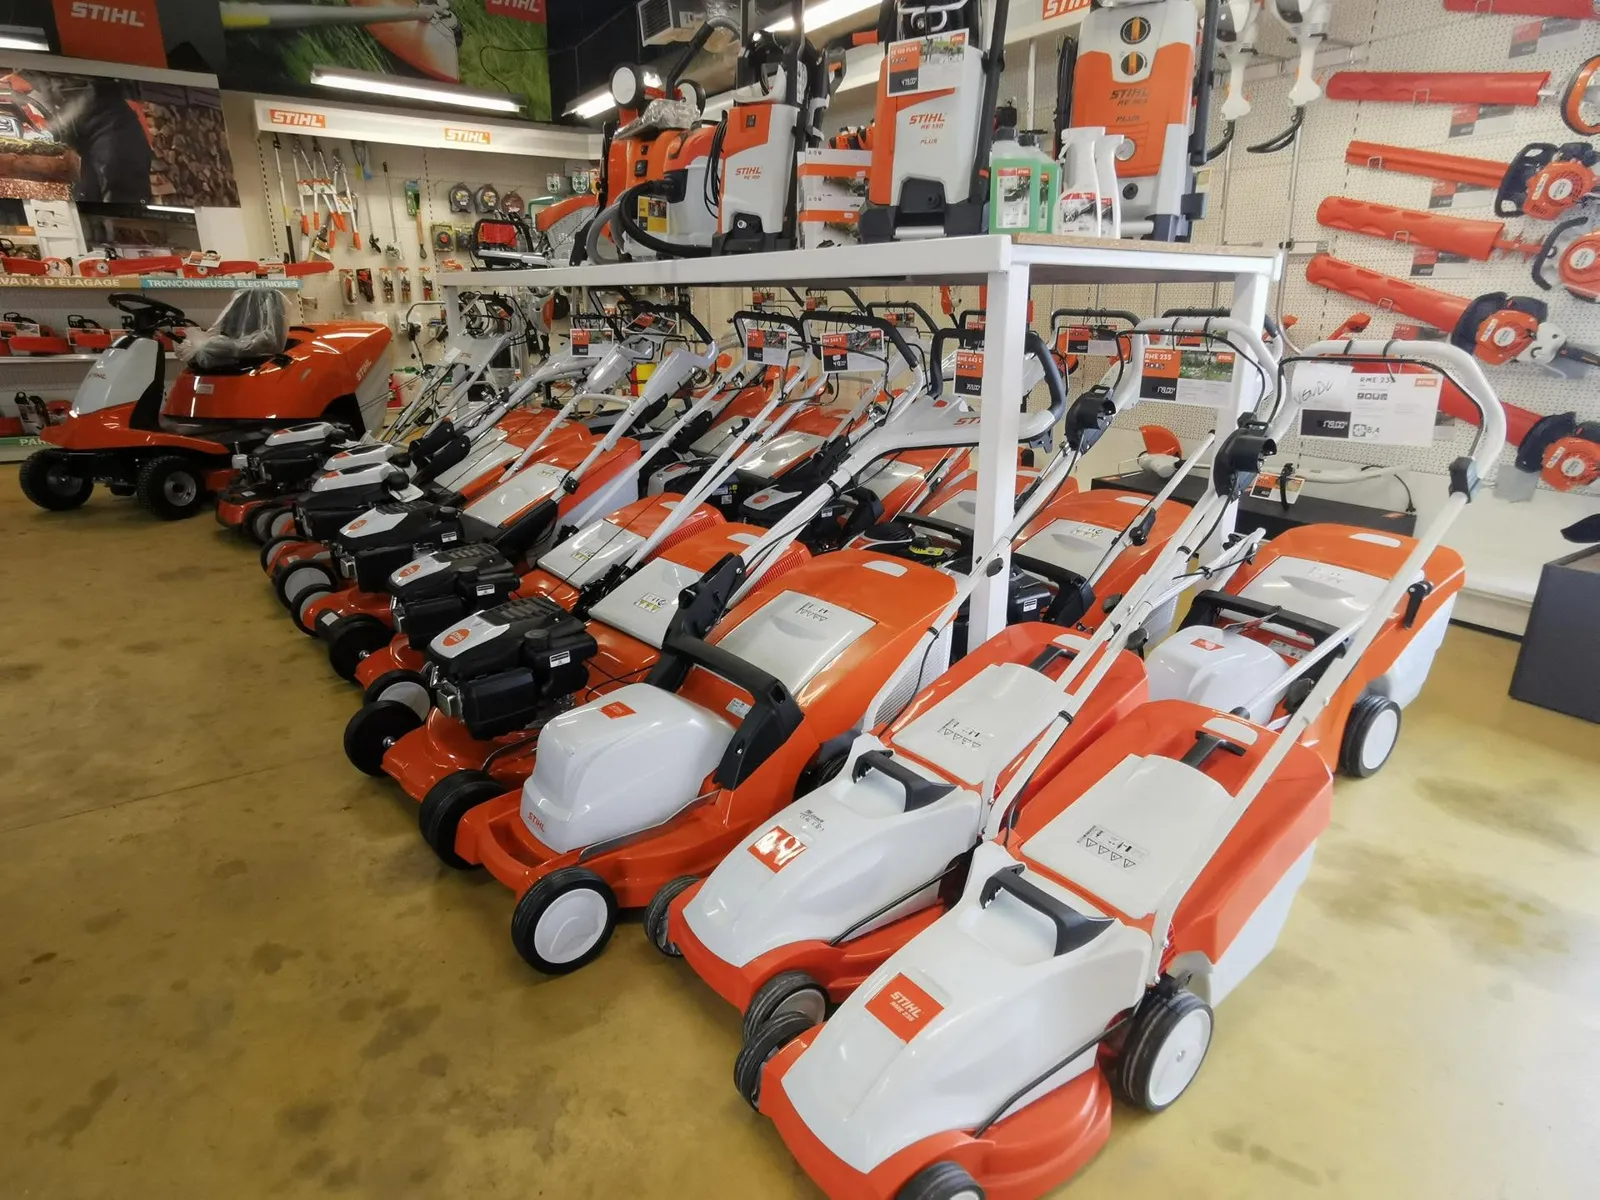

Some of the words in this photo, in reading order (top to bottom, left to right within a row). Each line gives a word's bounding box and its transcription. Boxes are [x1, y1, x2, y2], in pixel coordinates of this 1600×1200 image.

[70, 1, 145, 28] STIHL
[1109, 87, 1149, 101] STIHL
[272, 110, 323, 128] STIHL
[909, 112, 946, 125] STIHL
[446, 129, 488, 144] STIHL
[920, 138, 938, 146] PLUS
[735, 166, 762, 175] STIHL
[0, 277, 41, 286] VAUX
[44, 276, 120, 287] D'ÉLAGAGE
[147, 279, 235, 289] TRONÇONNEUSES
[237, 278, 299, 288] ÉLECTRIQUES
[1360, 376, 1376, 384] RME
[528, 811, 545, 833] STIHL
[890, 991, 922, 1018] STIHL
